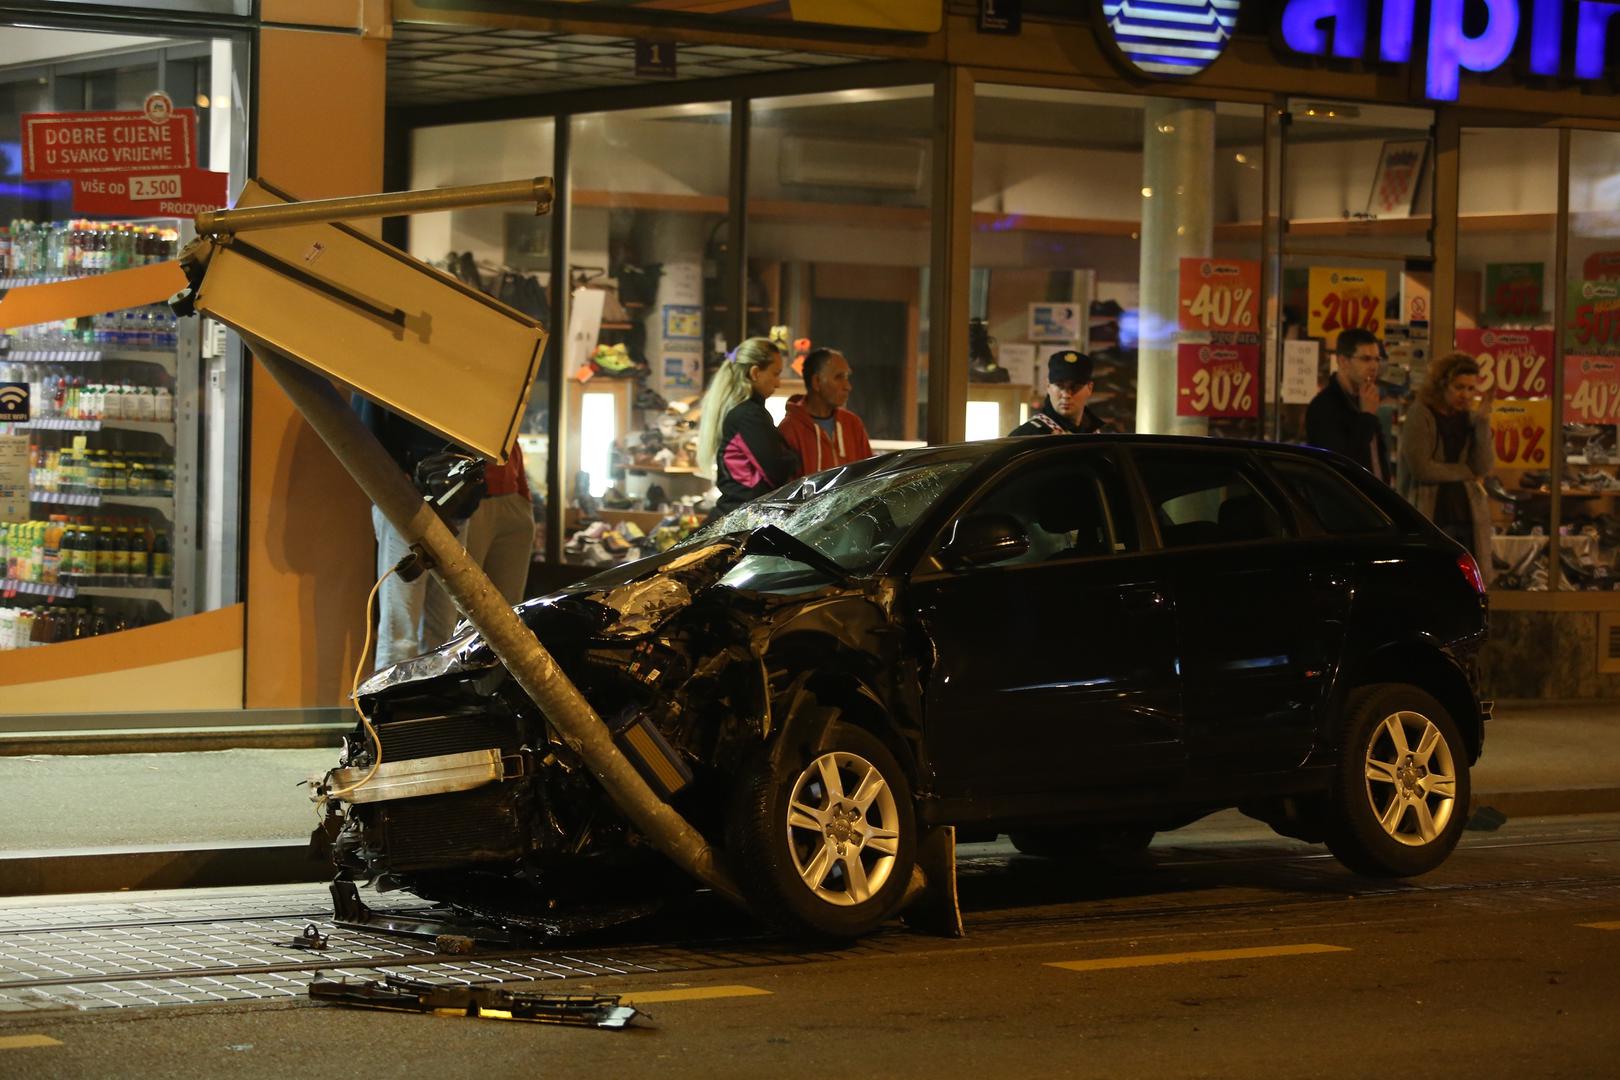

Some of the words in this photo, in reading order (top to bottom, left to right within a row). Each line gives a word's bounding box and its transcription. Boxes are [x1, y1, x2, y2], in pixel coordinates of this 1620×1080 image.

[45, 128, 107, 145] DOBRE
[113, 126, 172, 144] CIJENE
[46, 149, 57, 164] U
[61, 147, 109, 164] SVAKO
[112, 145, 173, 162] VRIJEME
[80, 179, 107, 194] VIŠE
[108, 182, 126, 195] OD
[135, 179, 178, 196] 2.500
[1182, 284, 1253, 328] -40%
[1312, 292, 1380, 333] -20%
[1180, 368, 1252, 412] -30%
[1489, 425, 1546, 464] 0%
